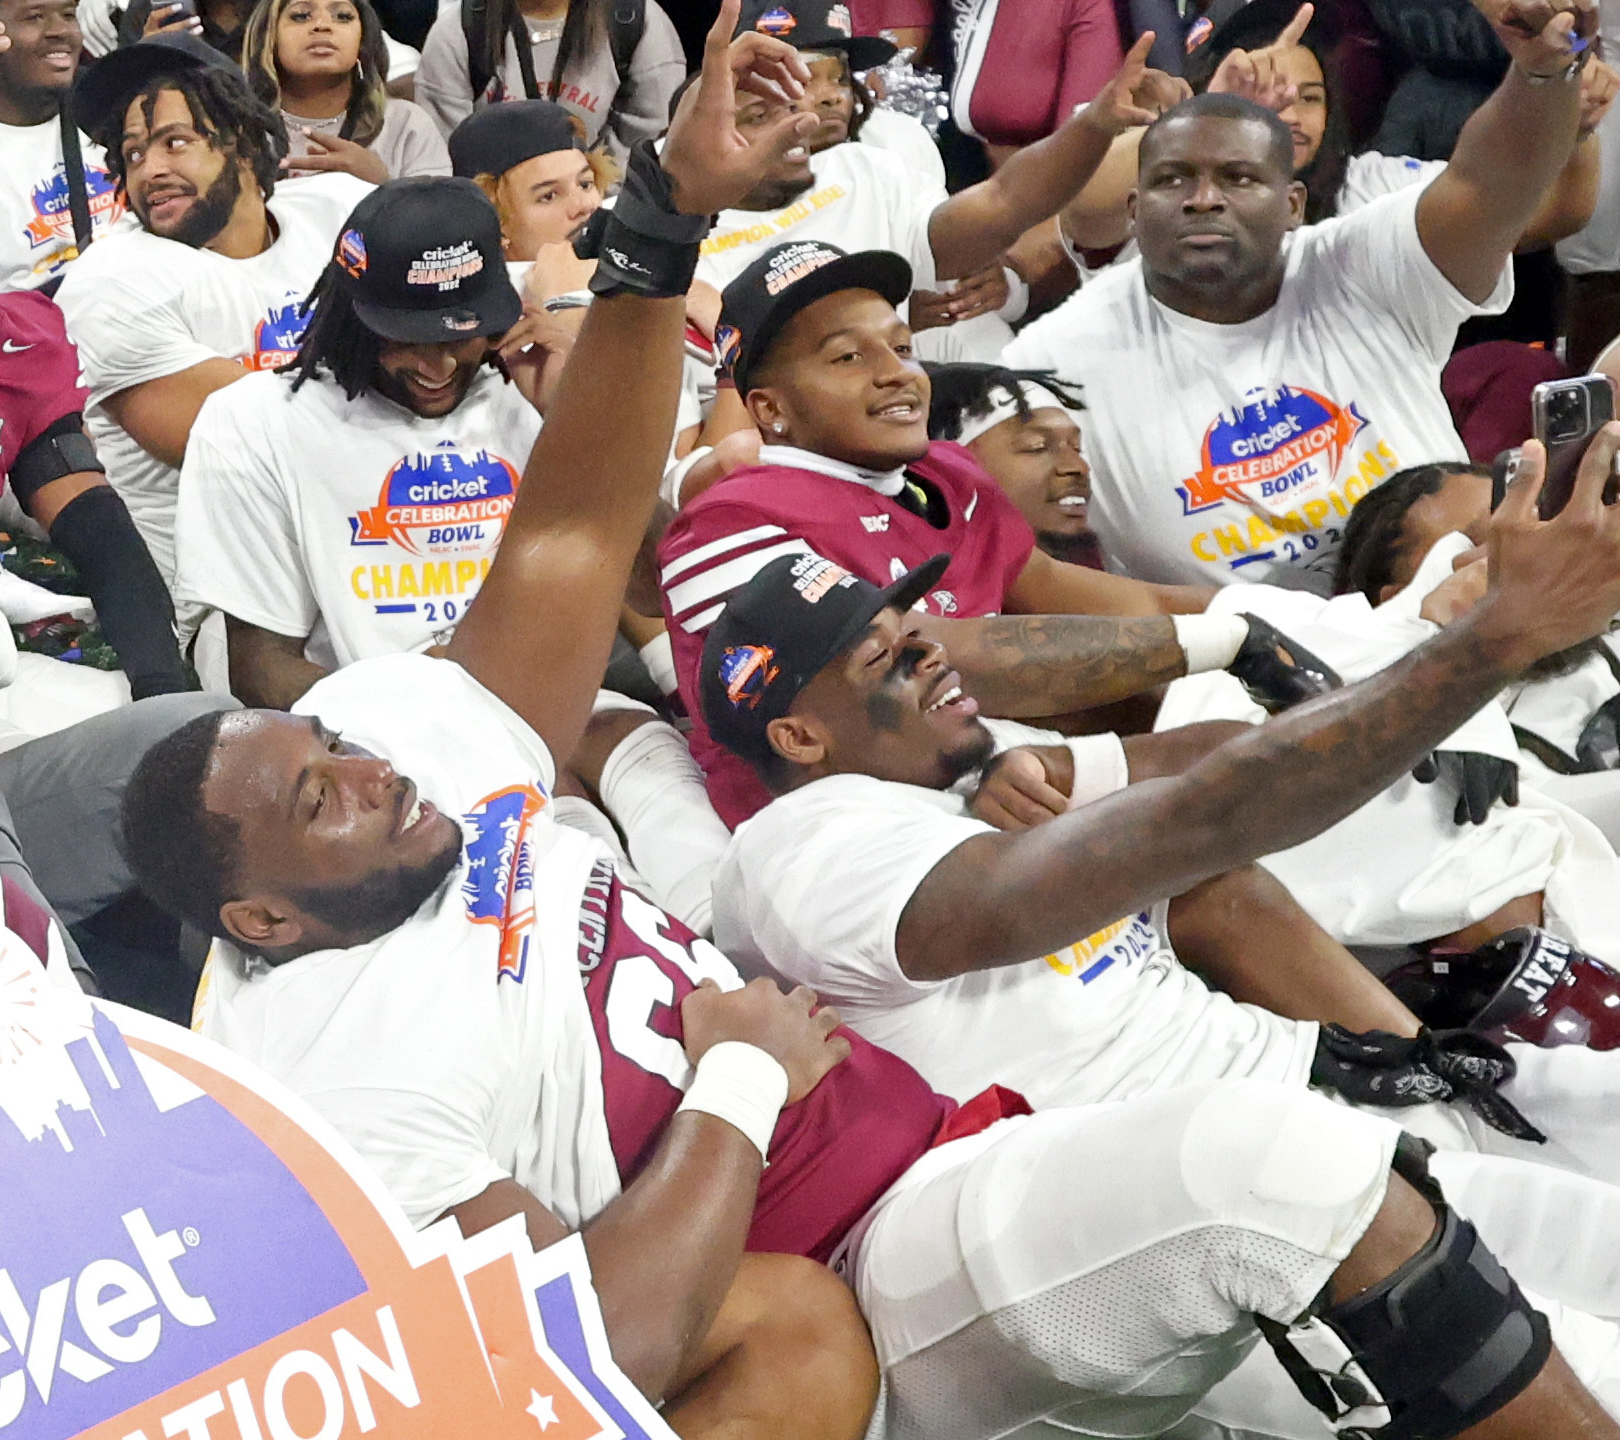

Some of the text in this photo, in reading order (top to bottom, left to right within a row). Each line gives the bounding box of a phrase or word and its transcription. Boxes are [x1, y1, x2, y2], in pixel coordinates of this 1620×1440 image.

[766, 203, 810, 231] WILL
[422, 241, 470, 262] cricket
[769, 242, 821, 269] cricket
[407, 258, 483, 286] CHAMPIONS
[411, 256, 457, 275] CELEBRATION
[438, 278, 461, 291] 2022
[1229, 411, 1304, 455] cricket
[1211, 423, 1342, 488] CELEBRATION
[407, 476, 490, 502] cricket
[1260, 460, 1318, 499] BOWL
[384, 496, 516, 526] CELEBRATION
[1189, 439, 1399, 565] CHAMPIONS
[427, 525, 487, 547] BOWL
[859, 513, 891, 533] MEAC
[428, 543, 482, 555] MEAC SWAC
